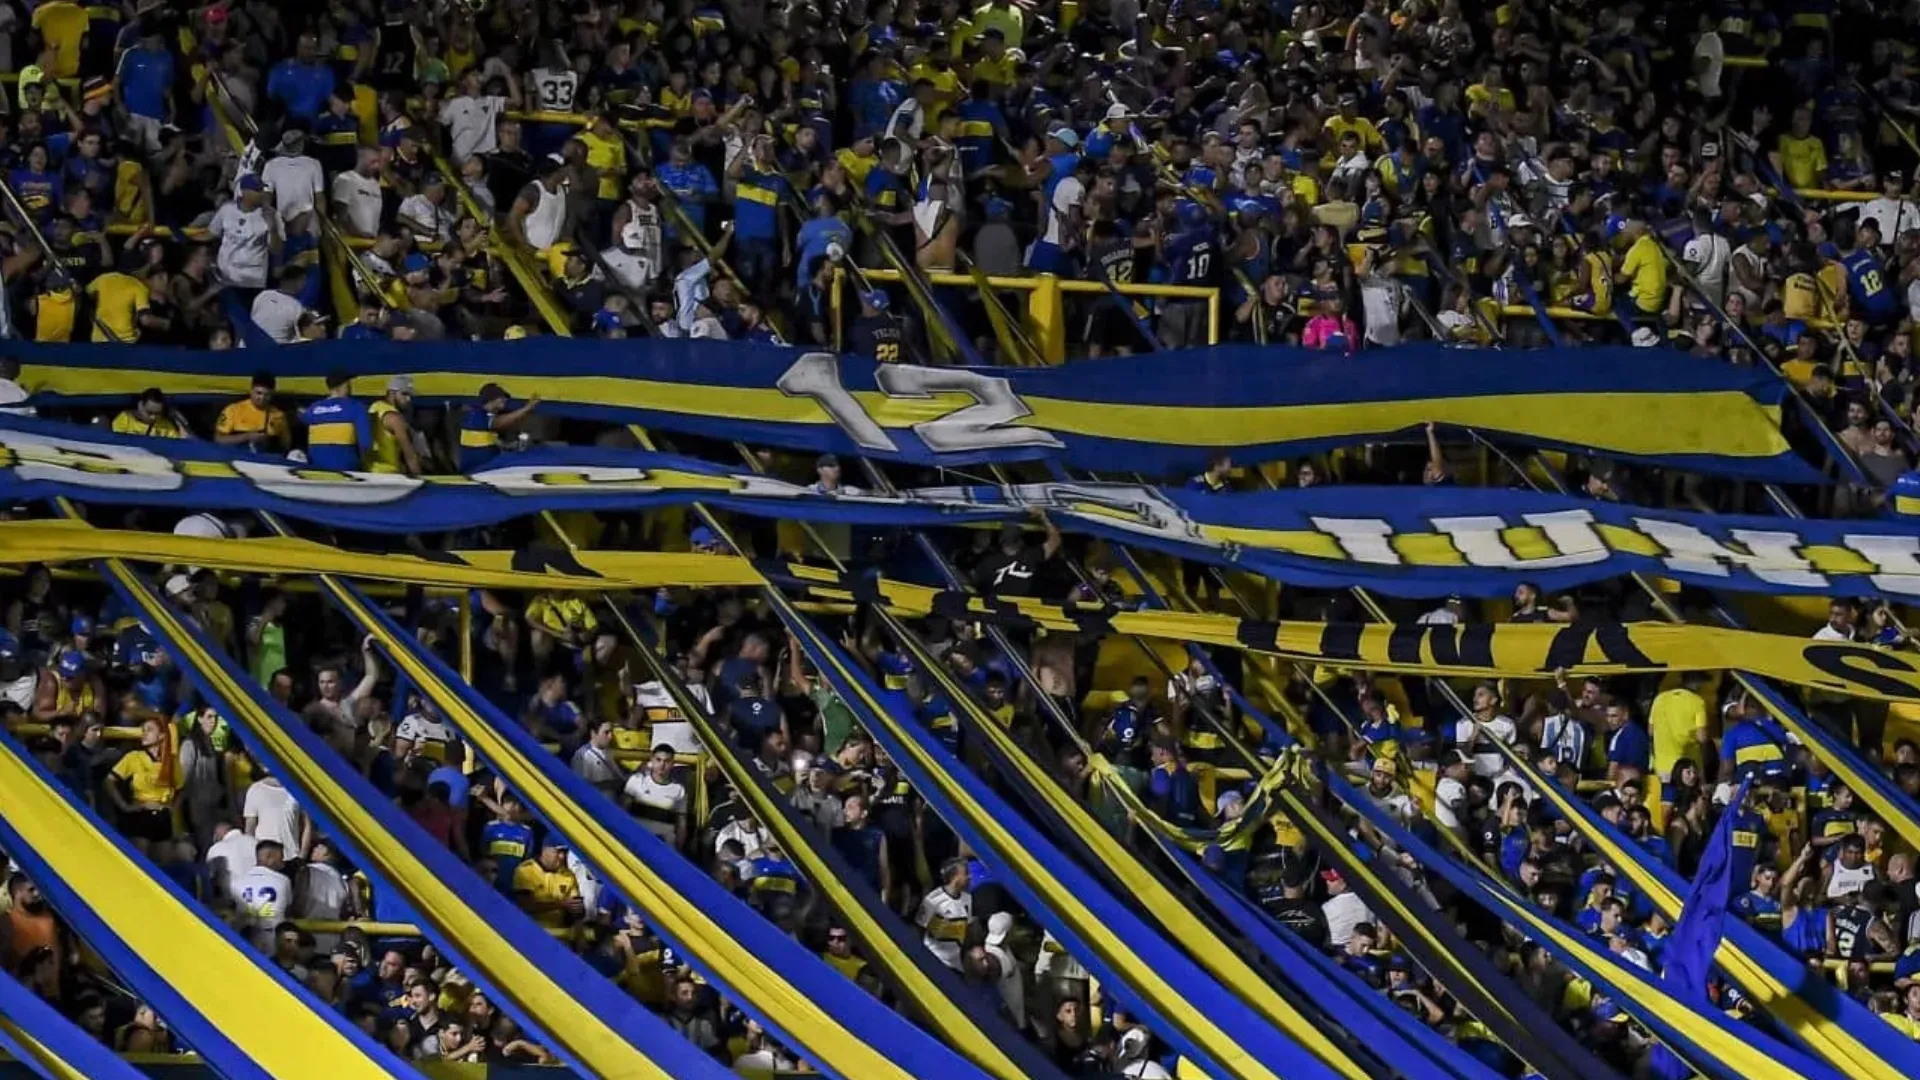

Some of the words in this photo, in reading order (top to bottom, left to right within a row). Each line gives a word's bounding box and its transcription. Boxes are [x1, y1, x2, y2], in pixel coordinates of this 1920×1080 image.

[382, 51, 406, 74] 12
[542, 79, 573, 105] 33
[1187, 253, 1210, 279] 10
[1859, 269, 1883, 299] 12
[875, 343, 900, 363] 22
[776, 352, 1067, 452] 12
